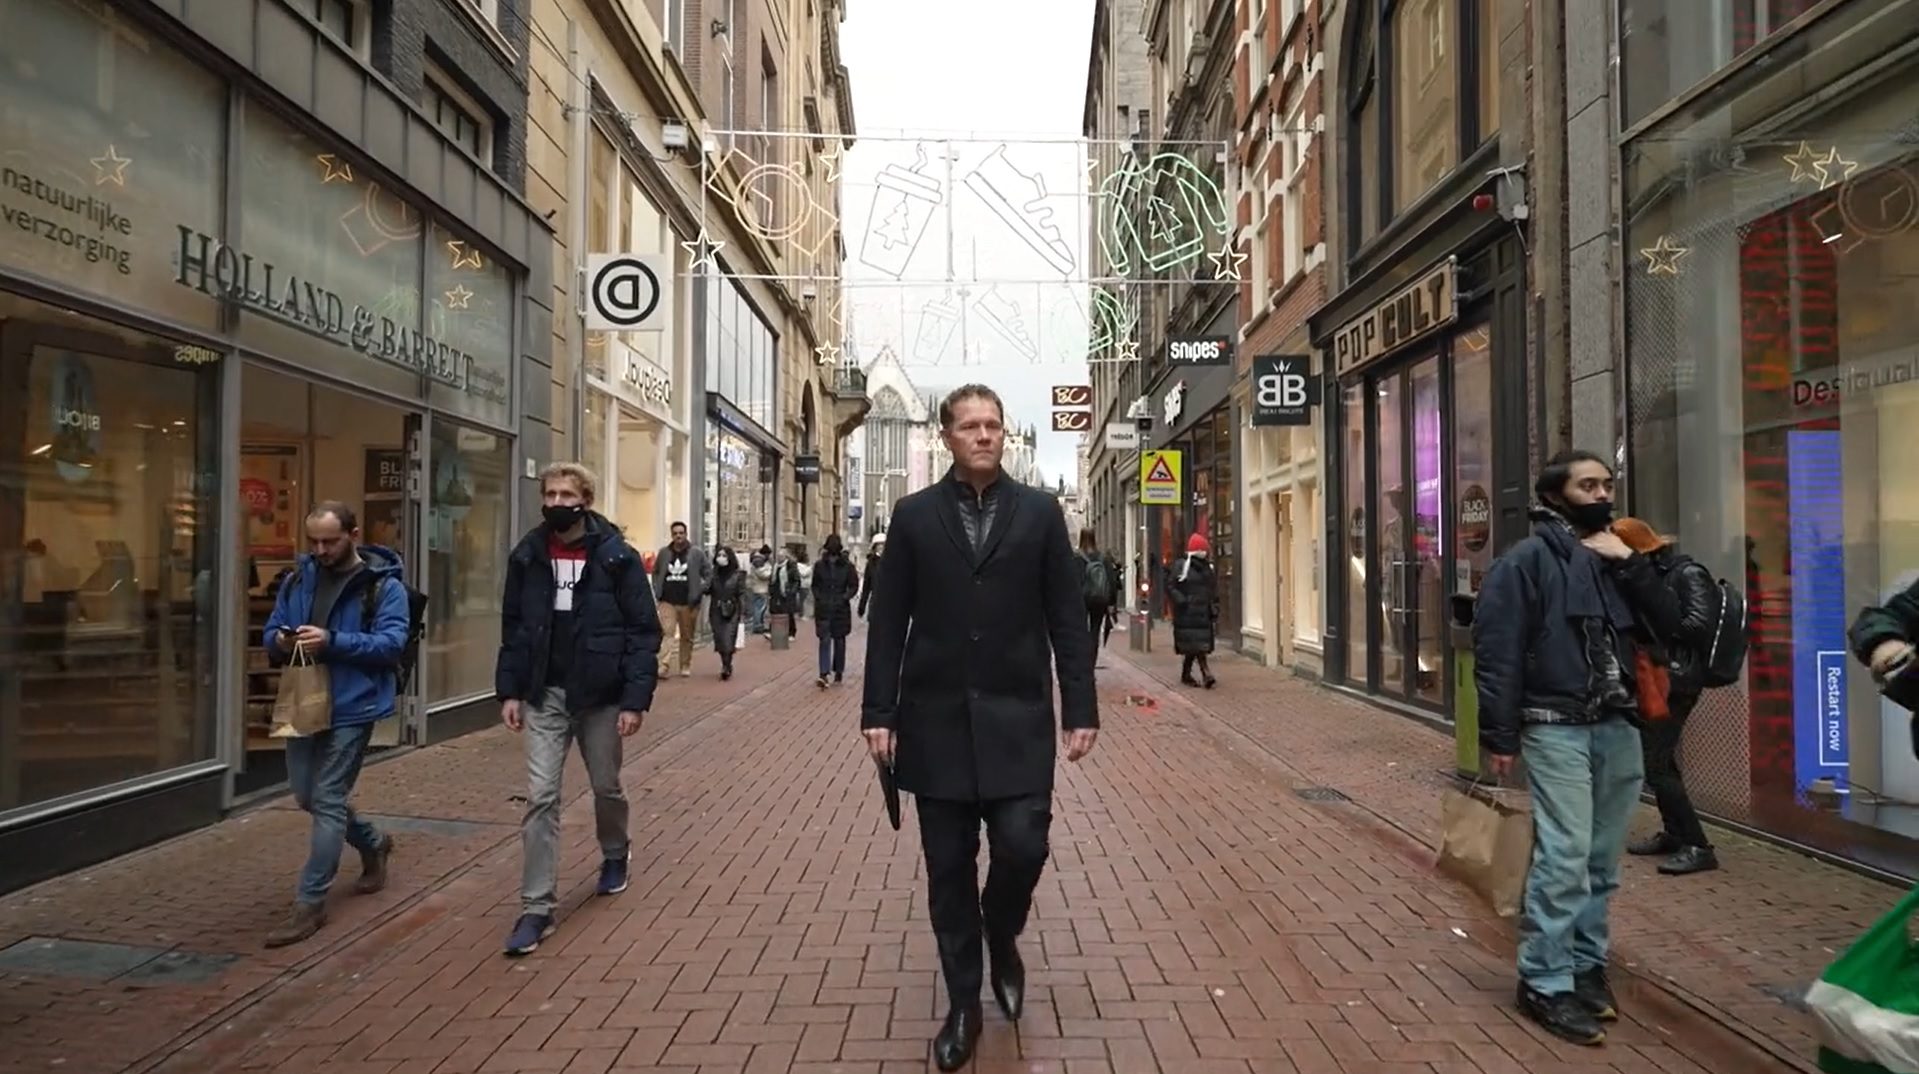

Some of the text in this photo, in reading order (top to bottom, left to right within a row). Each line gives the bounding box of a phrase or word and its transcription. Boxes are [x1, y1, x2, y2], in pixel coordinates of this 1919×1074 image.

[2, 168, 132, 236] natuurlijke
[1, 203, 131, 275] verzorging
[174, 224, 474, 393] HOLLAND & BARRETT
[1338, 272, 1444, 371] POP CULT
[1170, 341, 1220, 362] snipes
[1054, 387, 1088, 404] BC
[1054, 413, 1088, 430] BC
[1461, 510, 1488, 524] FRIDAY
[1463, 499, 1486, 512] BLACK
[1827, 667, 1842, 752] Restart now
